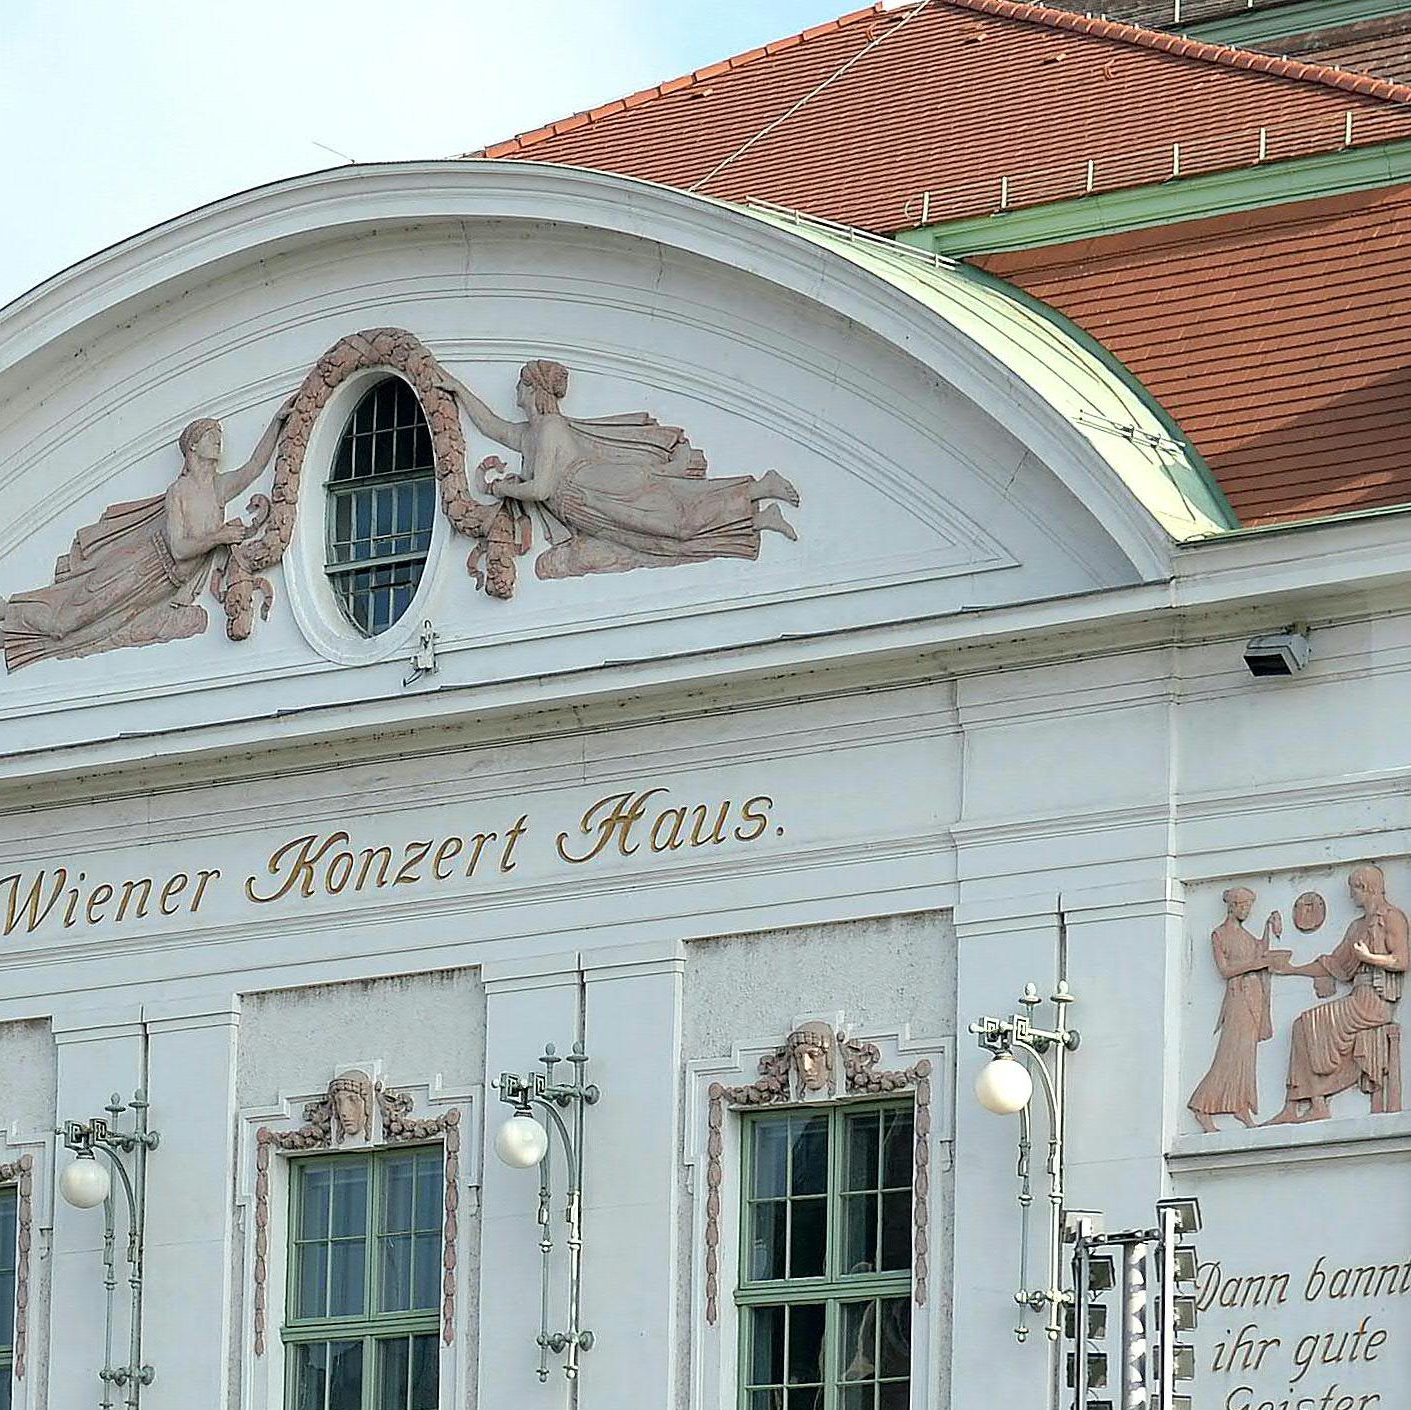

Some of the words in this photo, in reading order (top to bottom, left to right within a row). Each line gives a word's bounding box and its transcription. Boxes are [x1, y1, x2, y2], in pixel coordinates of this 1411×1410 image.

[246, 814, 528, 904] Konzert
[556, 787, 785, 864] Haus.
[1196, 1261, 1290, 1312] Dann
[1211, 1324, 1281, 1373] ihr
[1290, 1316, 1388, 1383] gute
